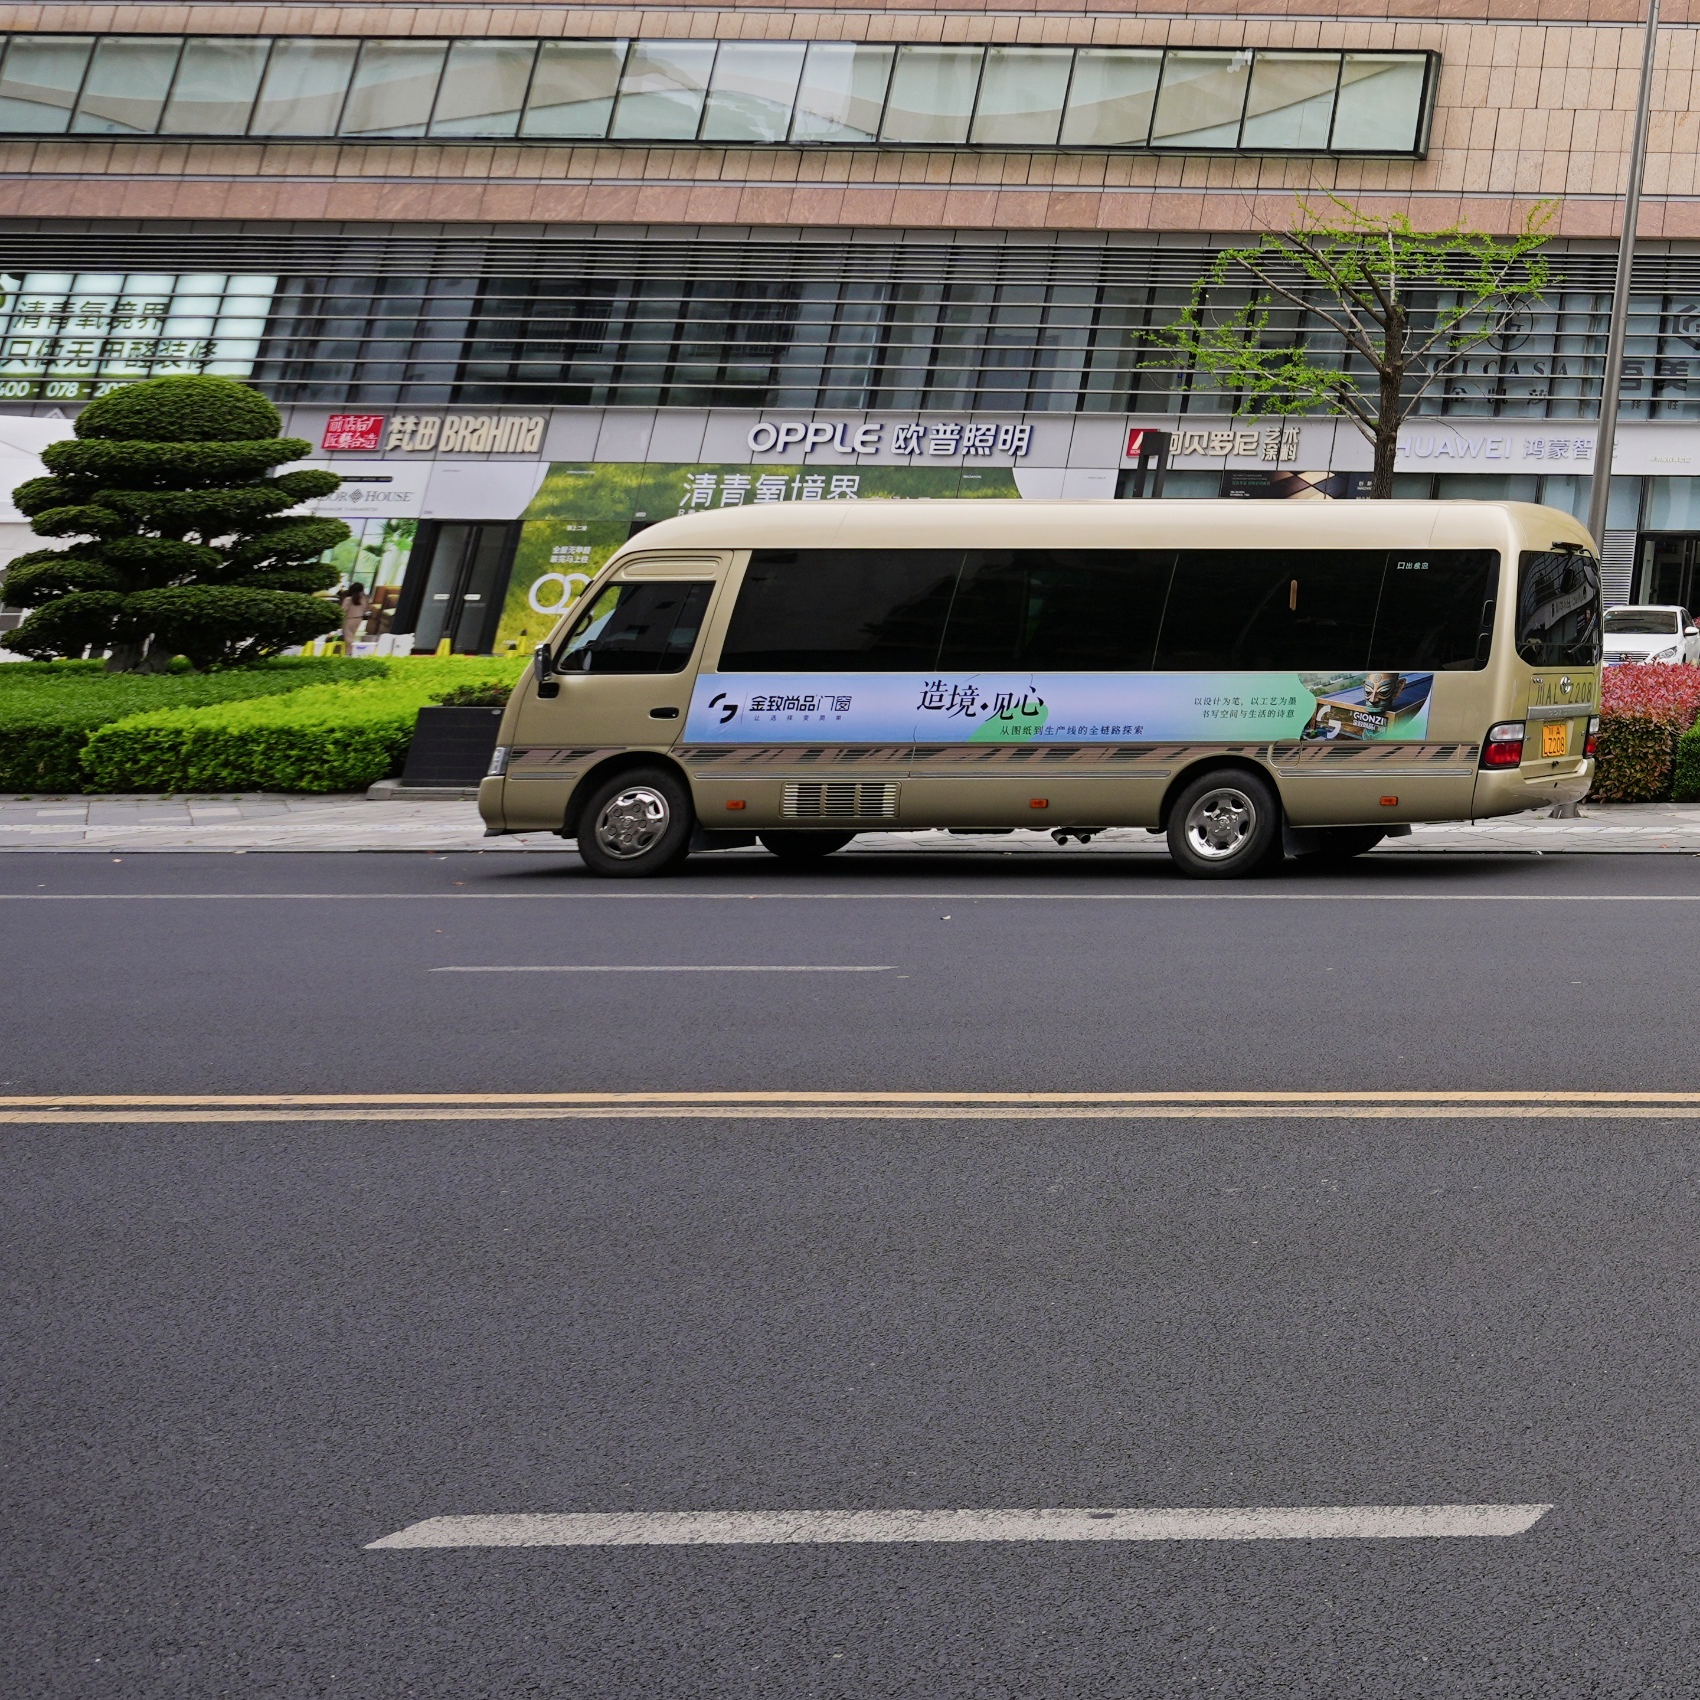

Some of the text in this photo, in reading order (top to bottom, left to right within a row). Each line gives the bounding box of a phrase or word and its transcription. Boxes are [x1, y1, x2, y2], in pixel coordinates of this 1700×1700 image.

[327, 415, 385, 433] 前店后厂
[384, 414, 442, 452] 梵田
[747, 422, 1034, 458] OPPLE 欧普照明
[1263, 426, 1300, 445] 艺术
[1260, 443, 1298, 462] 涂料
[1397, 435, 1618, 462] HUAWEI 鸿蒙智
[749, 695, 852, 712] 金致尚品门窗
[1201, 708, 1296, 719] 书写空间与生活的诗意
[1000, 725, 1145, 736] 从图纸到生产线的全链路探索
